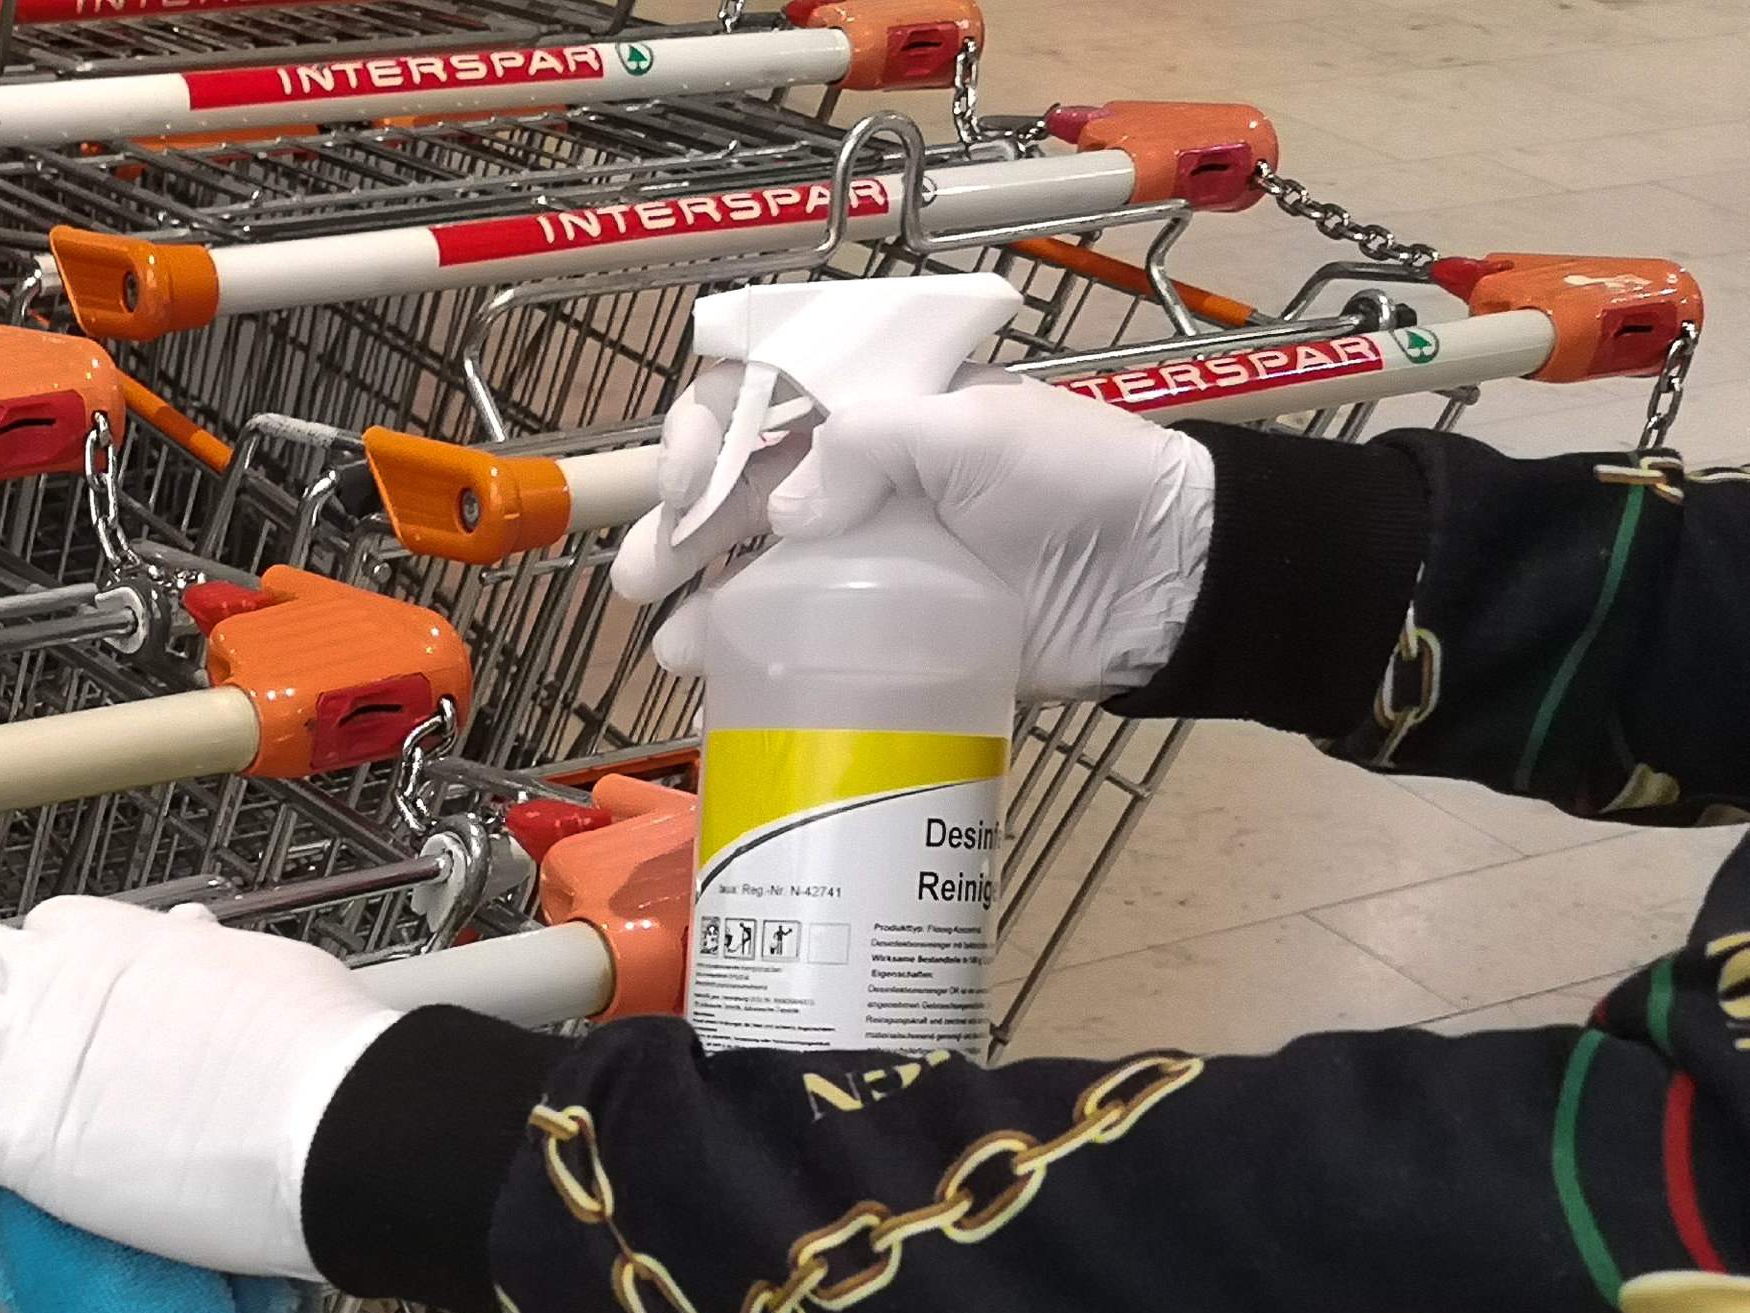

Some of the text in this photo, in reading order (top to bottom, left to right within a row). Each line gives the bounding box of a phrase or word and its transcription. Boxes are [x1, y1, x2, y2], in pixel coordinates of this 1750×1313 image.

[276, 47, 600, 96] INTERSPAR
[536, 179, 886, 244] INTERSPAR
[1062, 336, 1381, 402] TERSPAR
